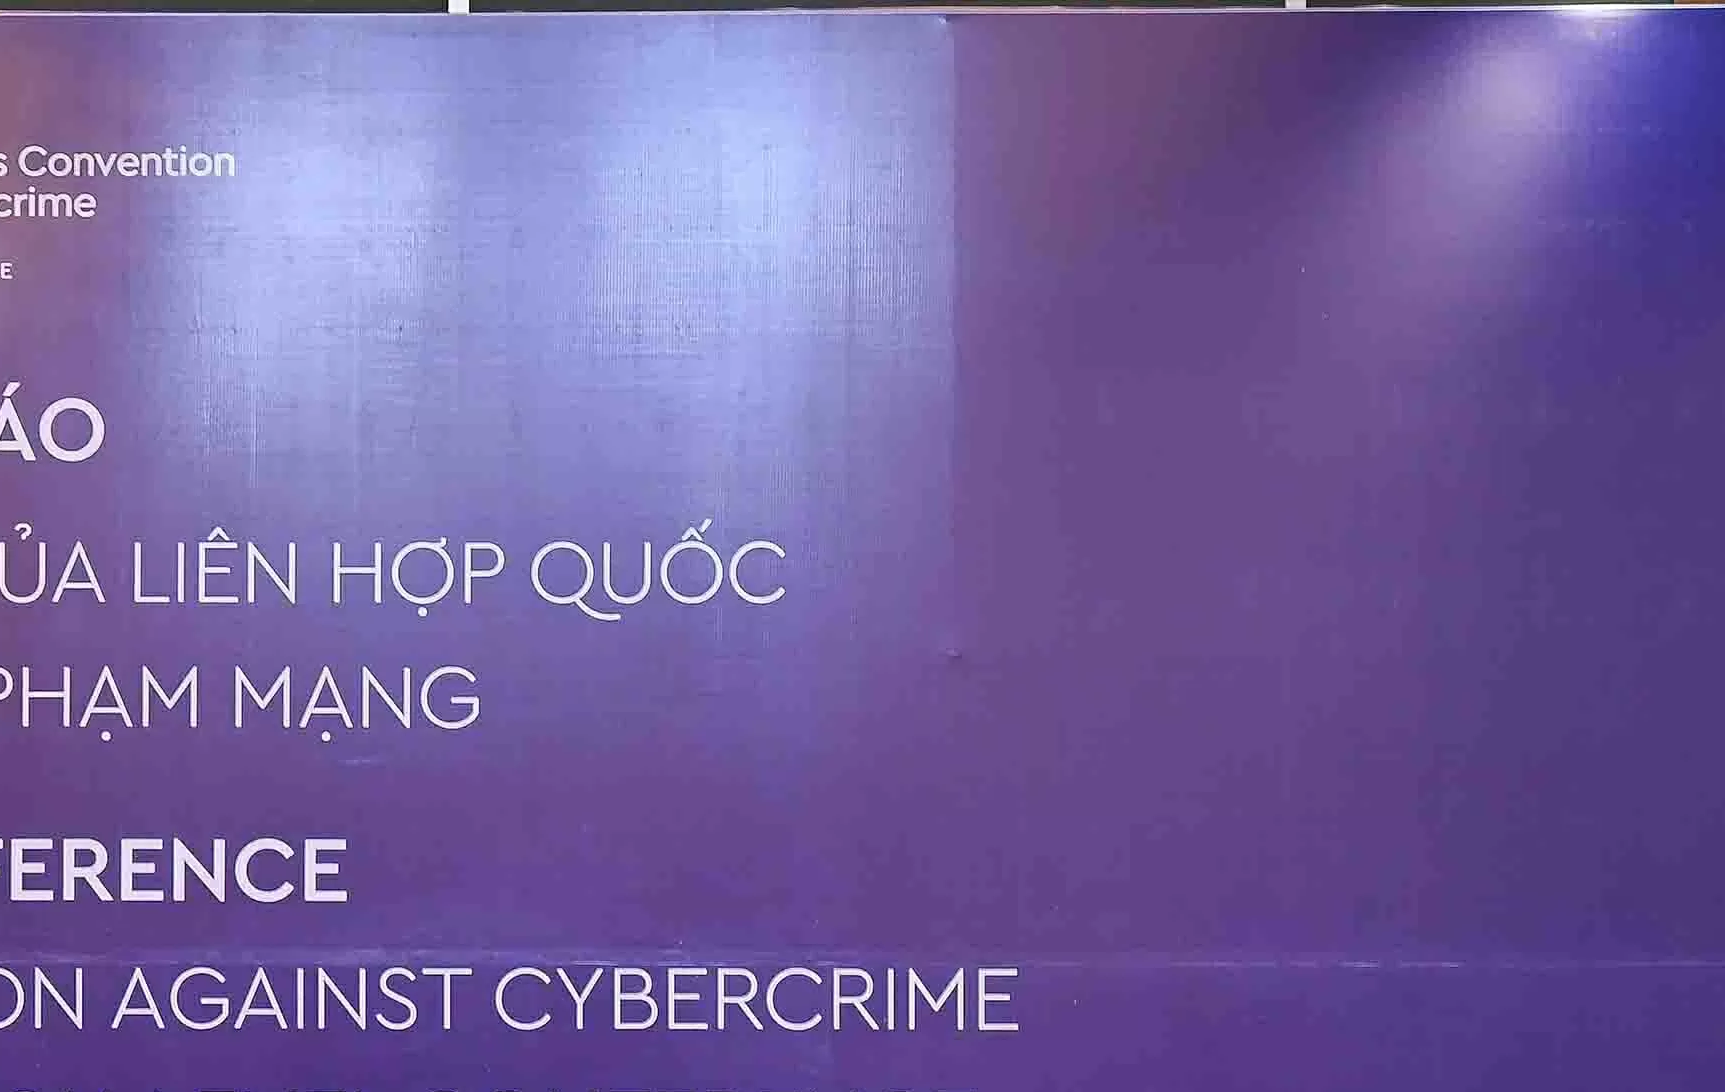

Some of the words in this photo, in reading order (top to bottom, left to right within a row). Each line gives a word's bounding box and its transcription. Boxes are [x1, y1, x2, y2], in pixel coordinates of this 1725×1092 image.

[17, 145, 235, 177] Convention
[133, 526, 296, 605] LIÊN
[332, 536, 505, 617] HỢP
[530, 518, 786, 621] QUỐC
[234, 664, 480, 741] MẠNG
[111, 966, 472, 1031] AGAINST
[495, 966, 1019, 1032] CYBERCRIME
